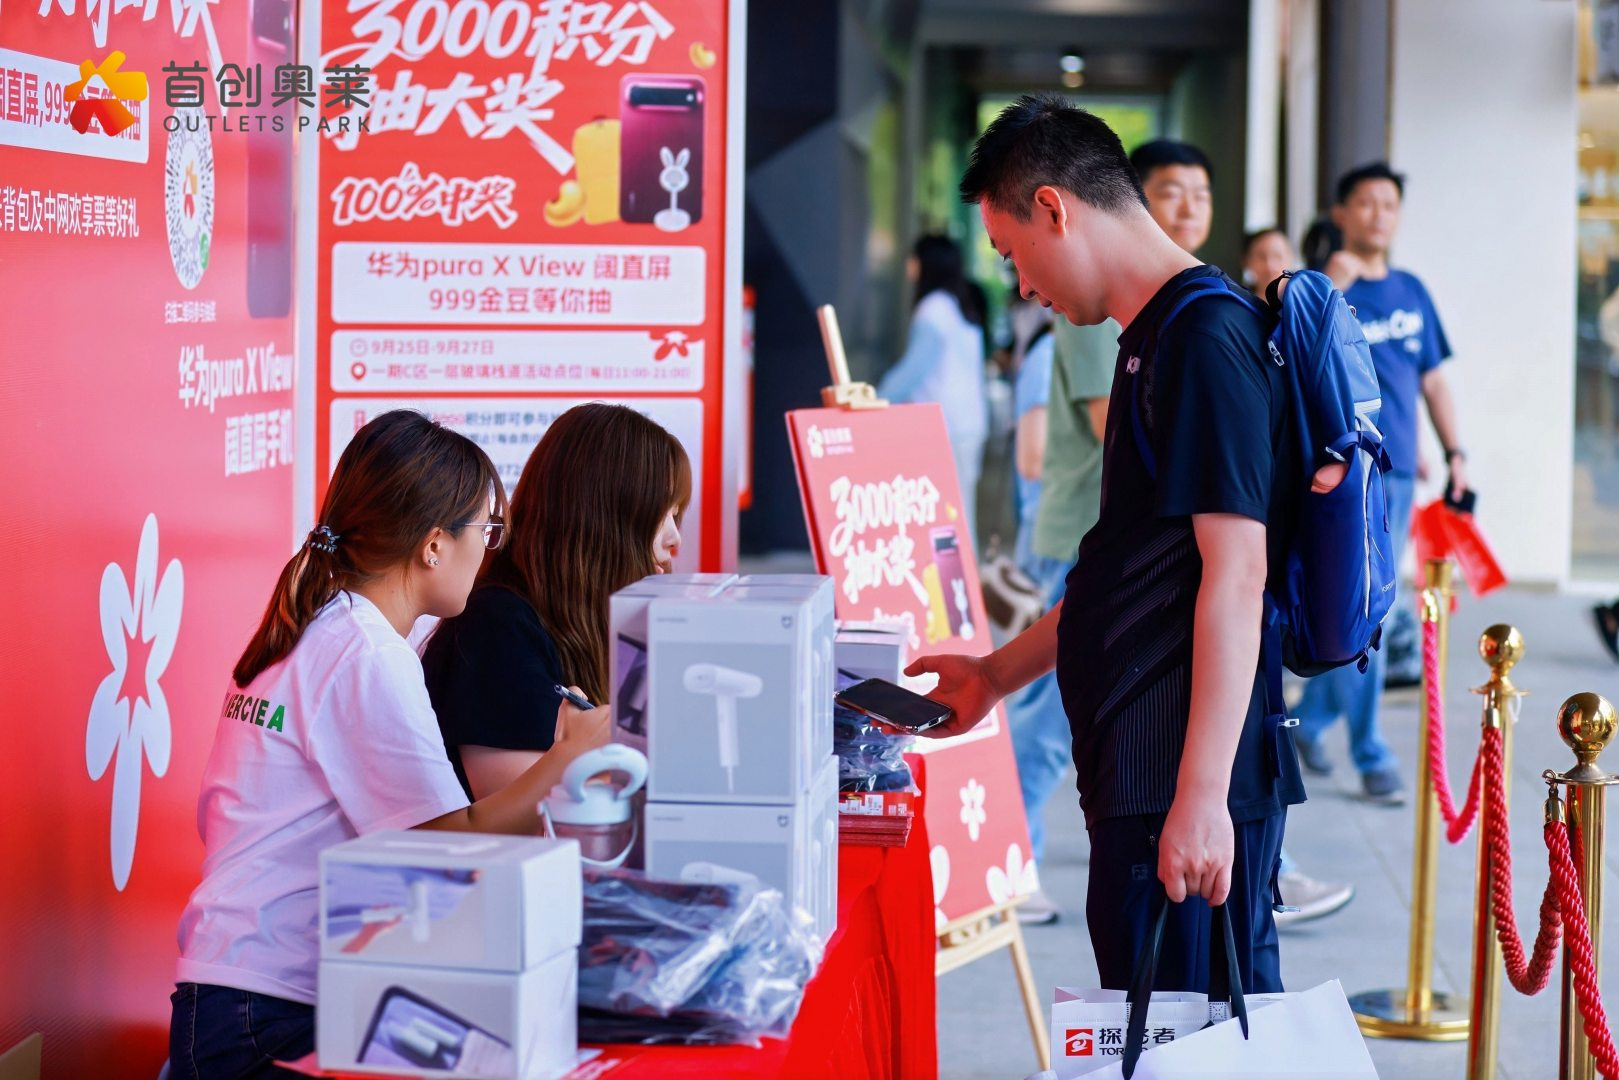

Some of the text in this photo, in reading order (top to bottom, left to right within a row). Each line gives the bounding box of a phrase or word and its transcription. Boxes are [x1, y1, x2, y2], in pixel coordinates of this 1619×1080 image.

[0, 185, 140, 238] 背包及中网欢享票等好礼
[330, 161, 518, 229] 100%中奖
[367, 250, 671, 281] 华为pura X View 阔直屏
[428, 286, 613, 315] 999金豆等你抽
[245, 347, 258, 394] X
